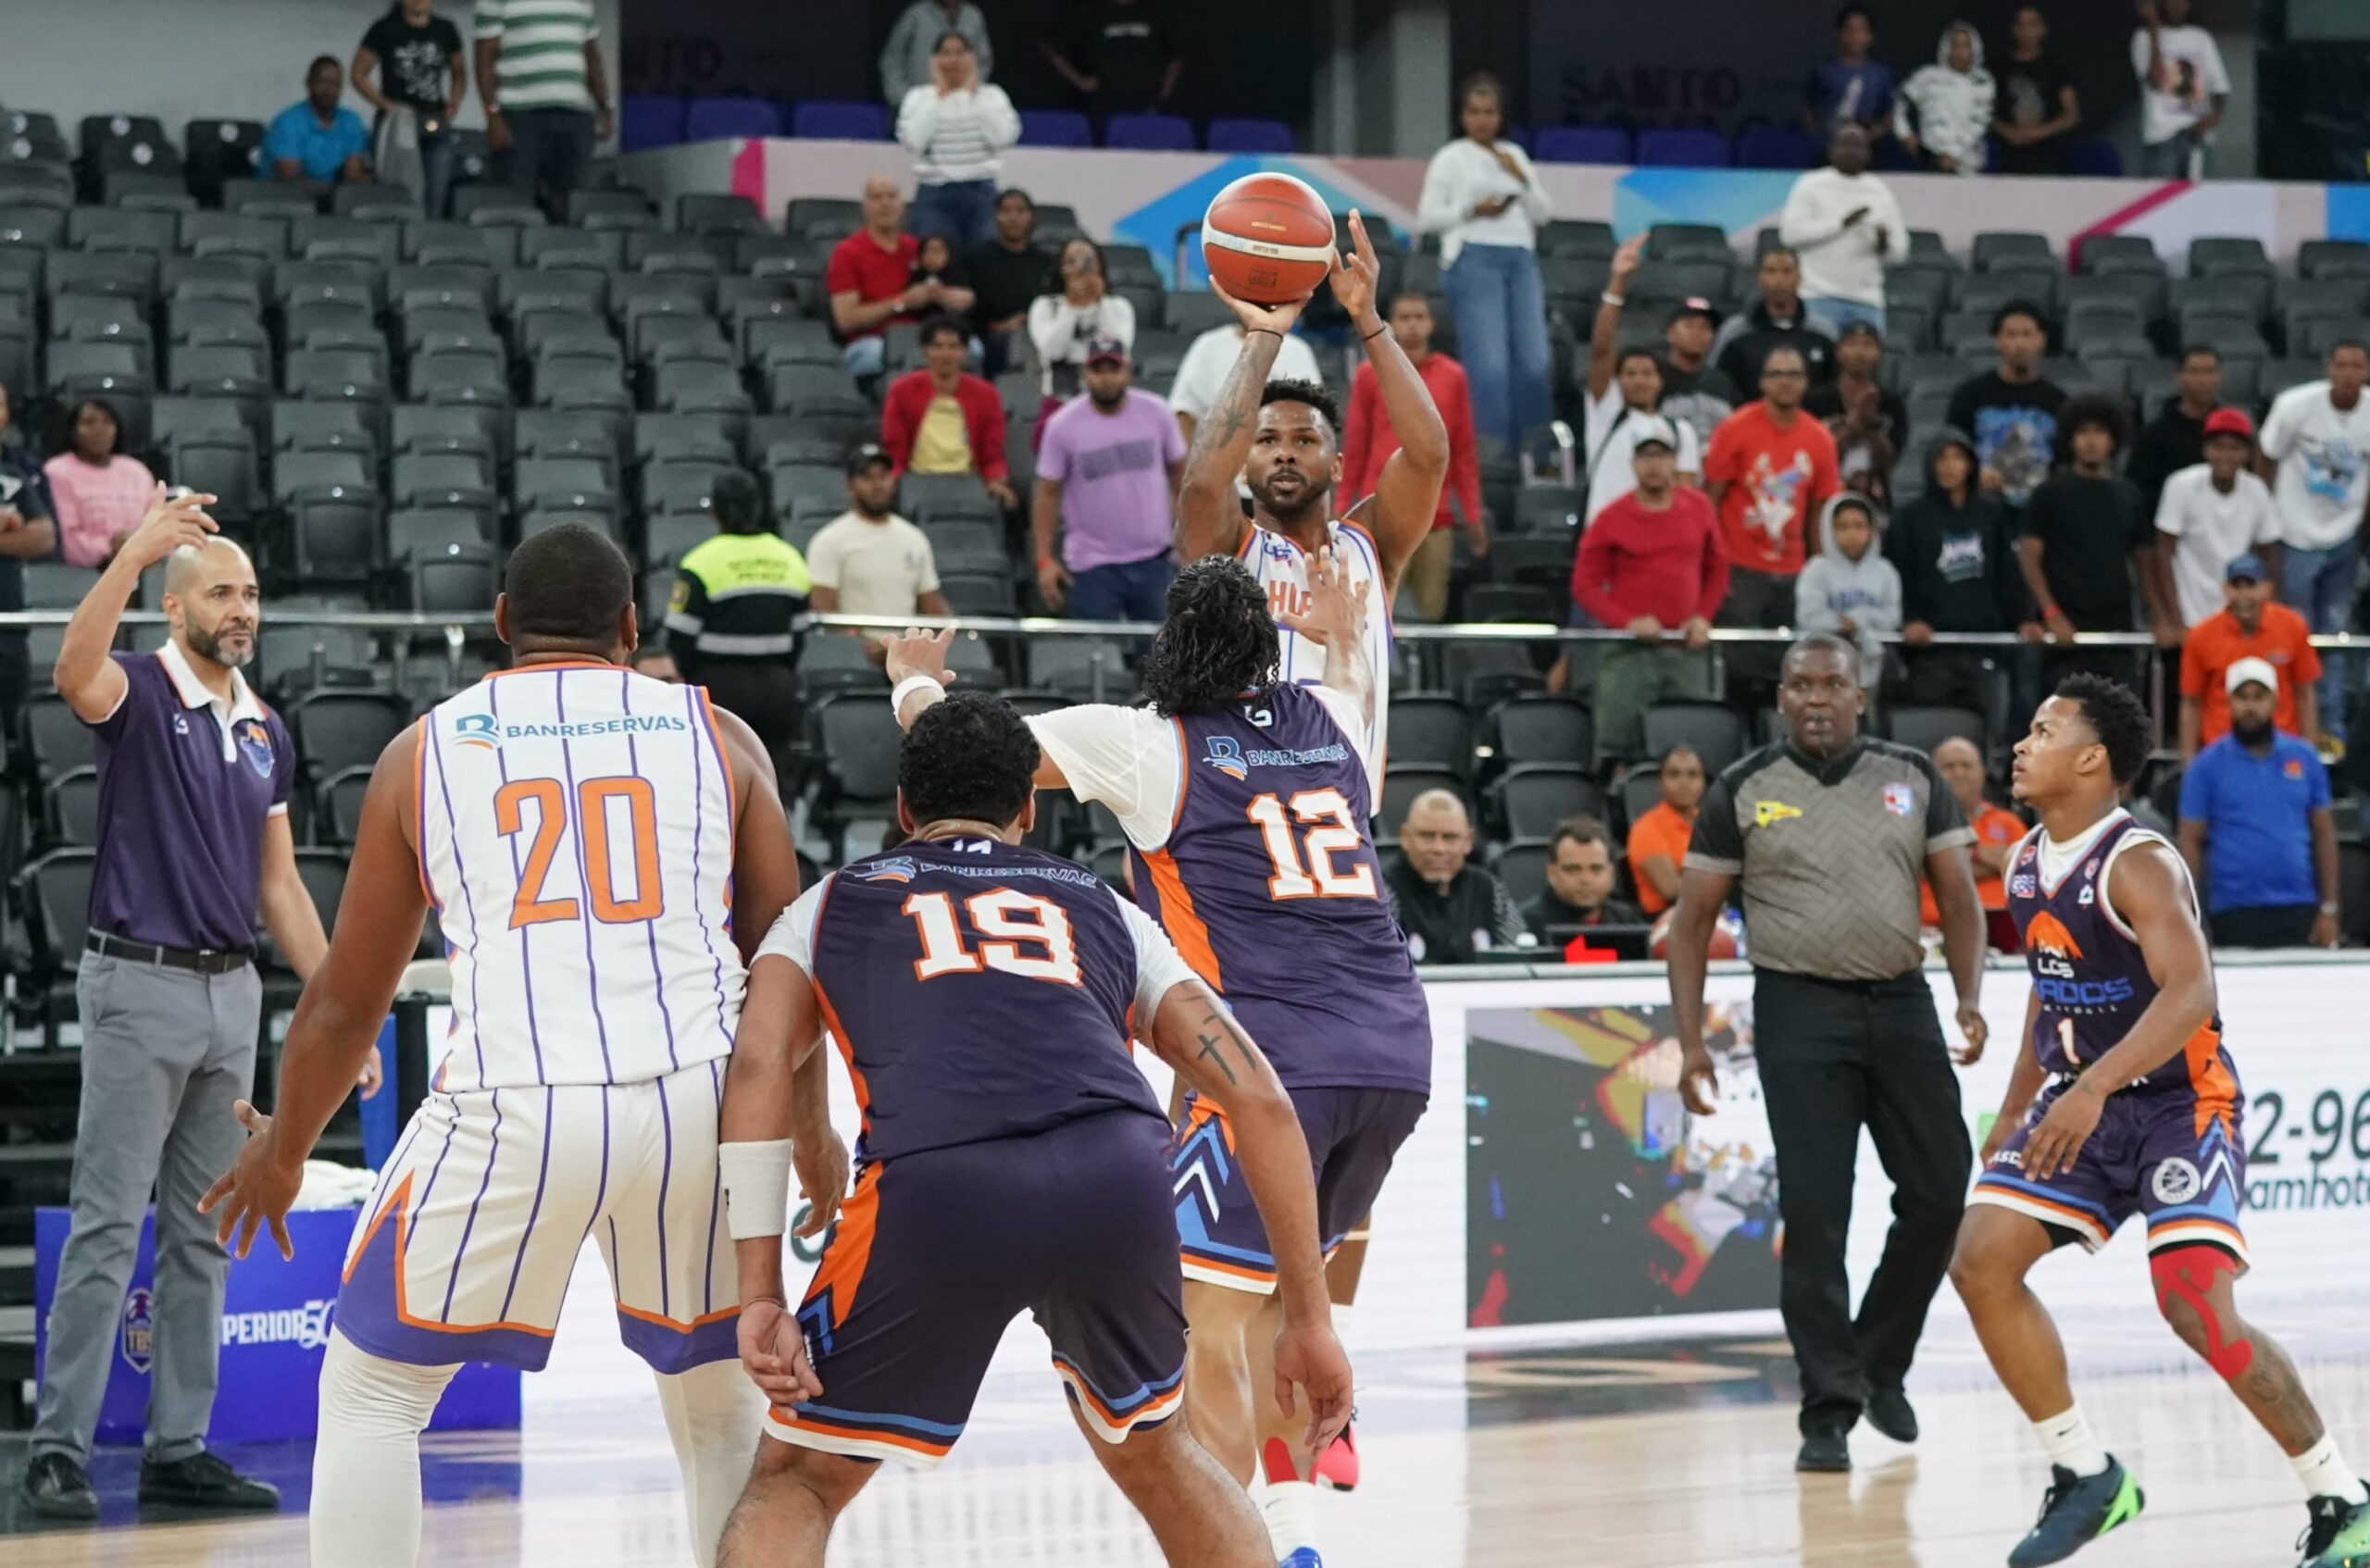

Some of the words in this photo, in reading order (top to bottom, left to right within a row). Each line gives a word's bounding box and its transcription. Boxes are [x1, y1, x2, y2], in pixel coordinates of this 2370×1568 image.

[505, 716, 687, 739] BANRESERVAS
[1246, 743, 1349, 766] BANRESERVAS
[493, 776, 665, 931] 20
[1245, 787, 1378, 902] 12
[901, 886, 1084, 989] 19
[2038, 956, 2075, 979] LOS
[2035, 977, 2135, 1005] ADOS
[2056, 1017, 2081, 1065] 1
[2244, 1162, 2370, 1211] amhot
[221, 1308, 306, 1345] PERIOR
